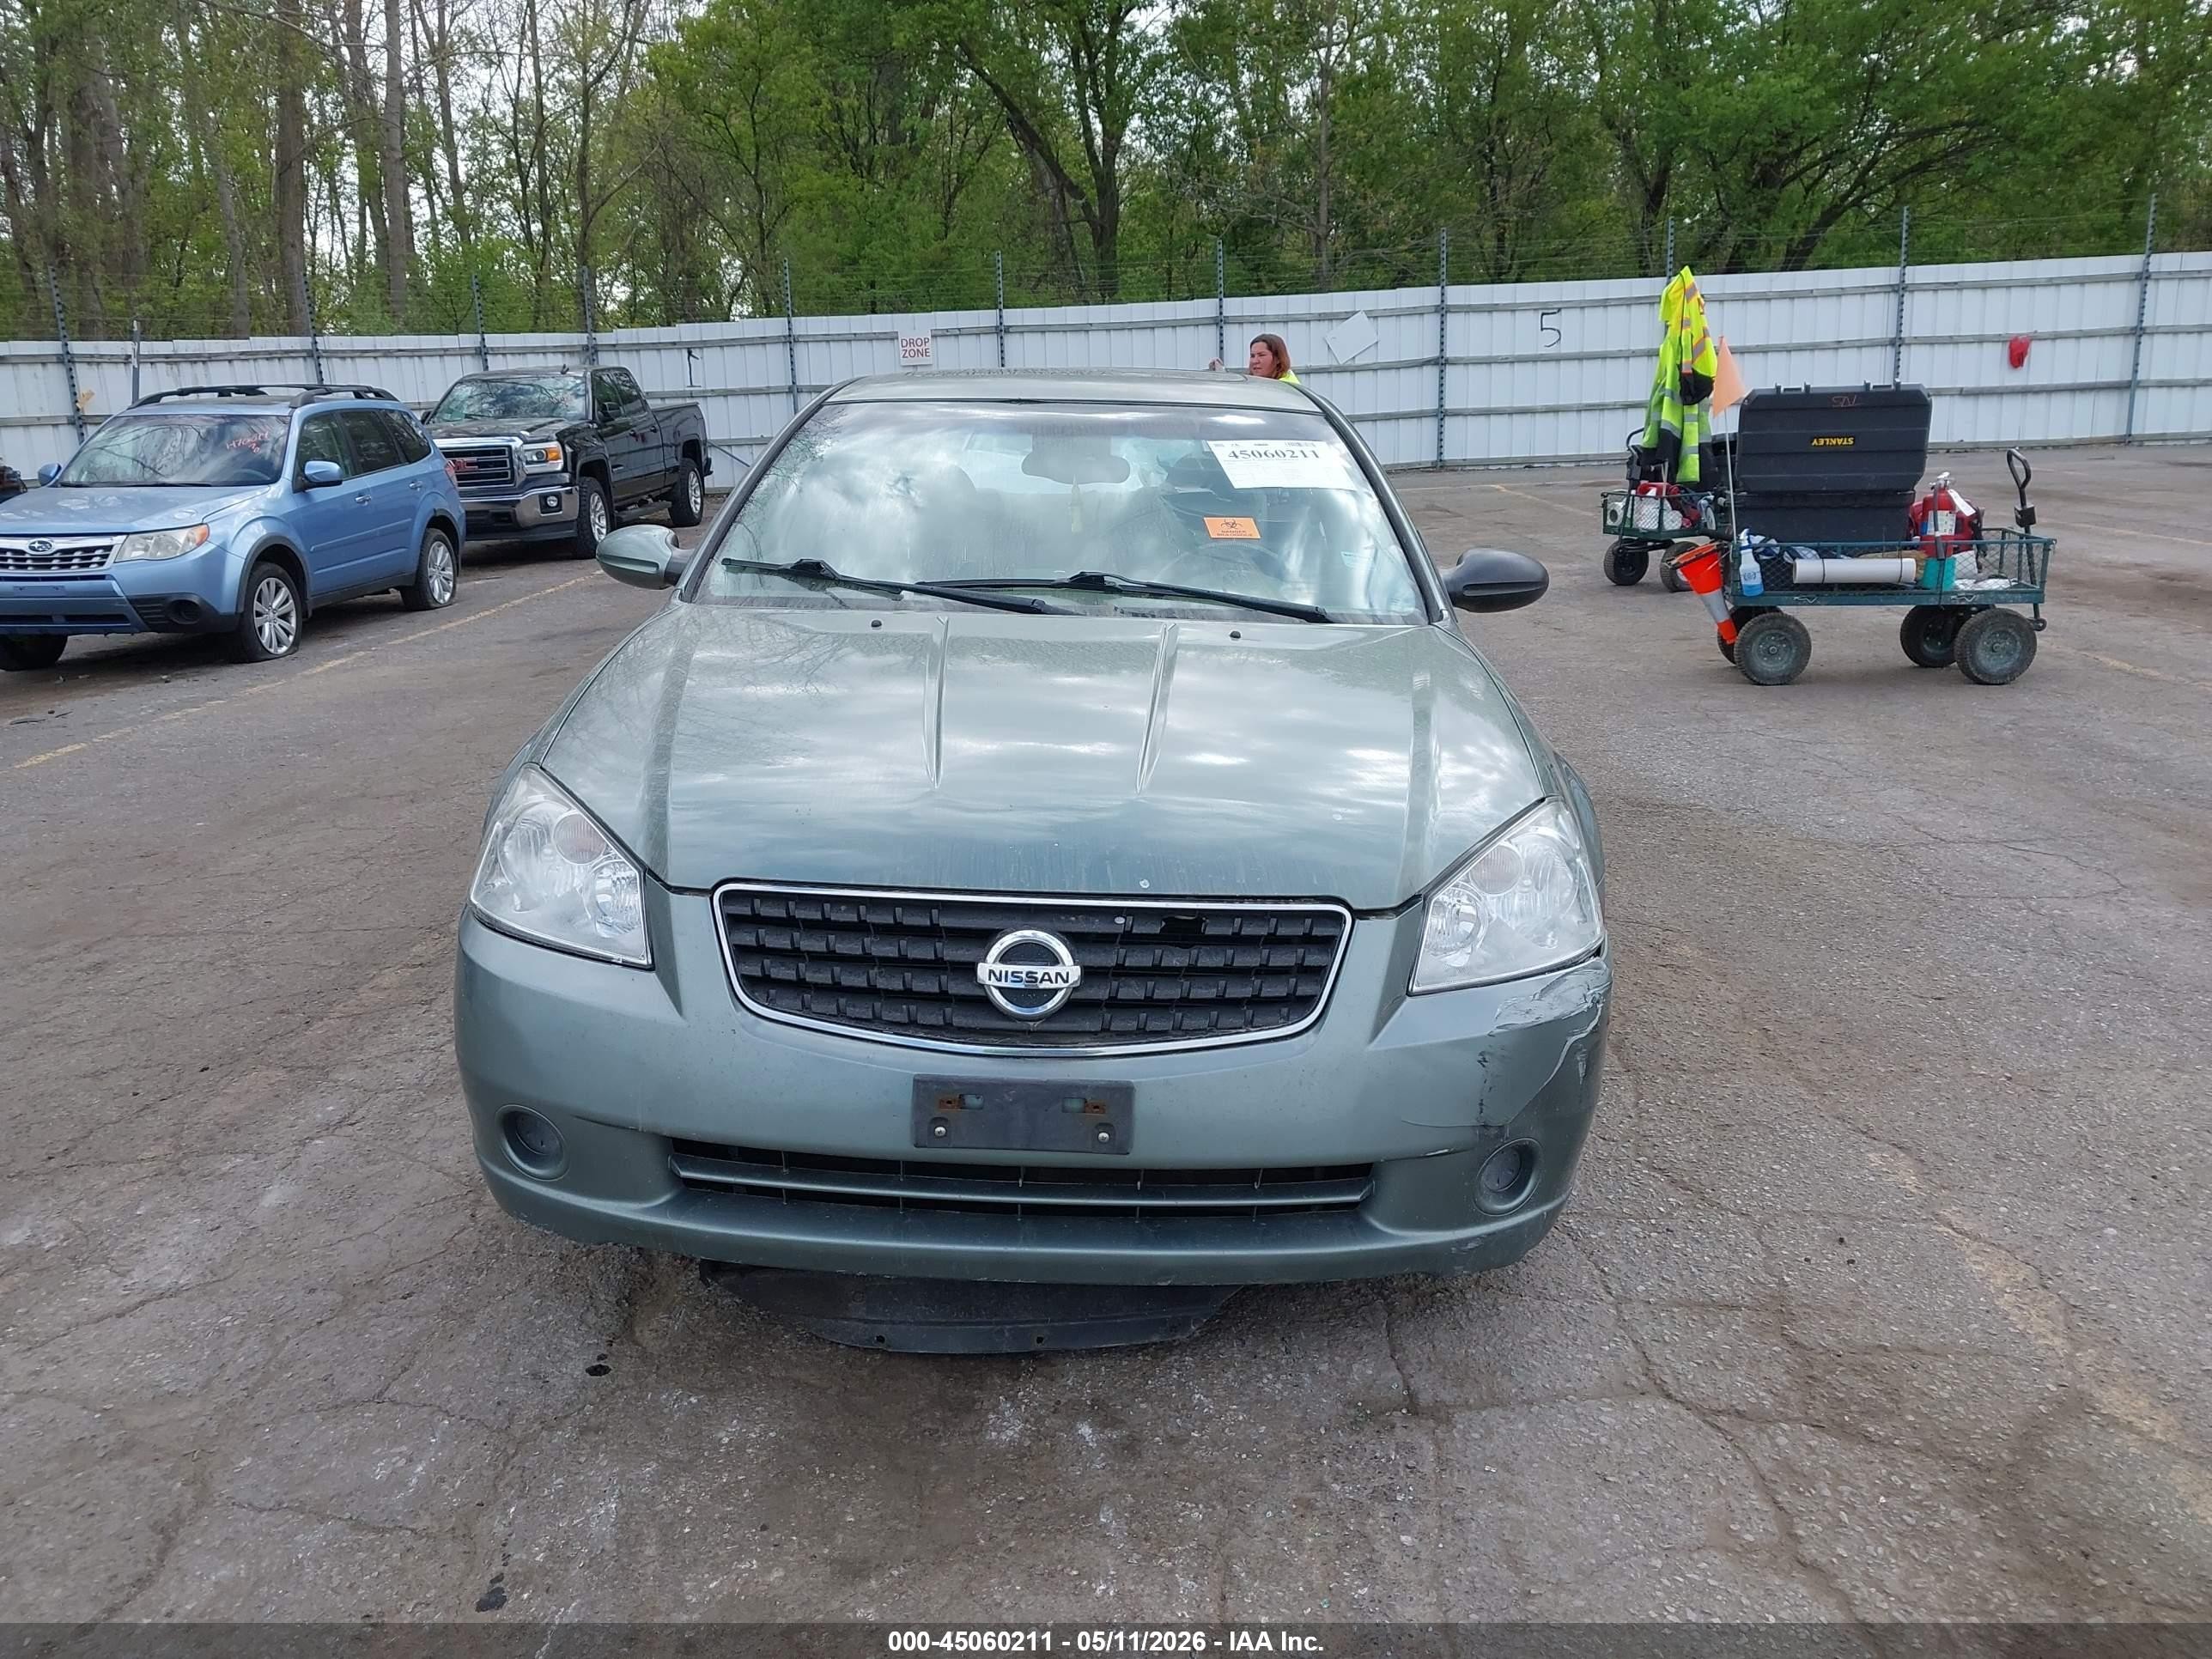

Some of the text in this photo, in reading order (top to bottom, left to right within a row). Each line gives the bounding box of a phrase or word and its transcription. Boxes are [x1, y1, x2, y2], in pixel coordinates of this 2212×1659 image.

[1540, 308, 1561, 348] 5
[901, 337, 930, 348] DROP
[902, 348, 931, 359] ZONE
[1811, 437, 1855, 447] STANLEY
[1228, 449, 1320, 459] 45060211
[988, 969, 1070, 984] NISSAN
